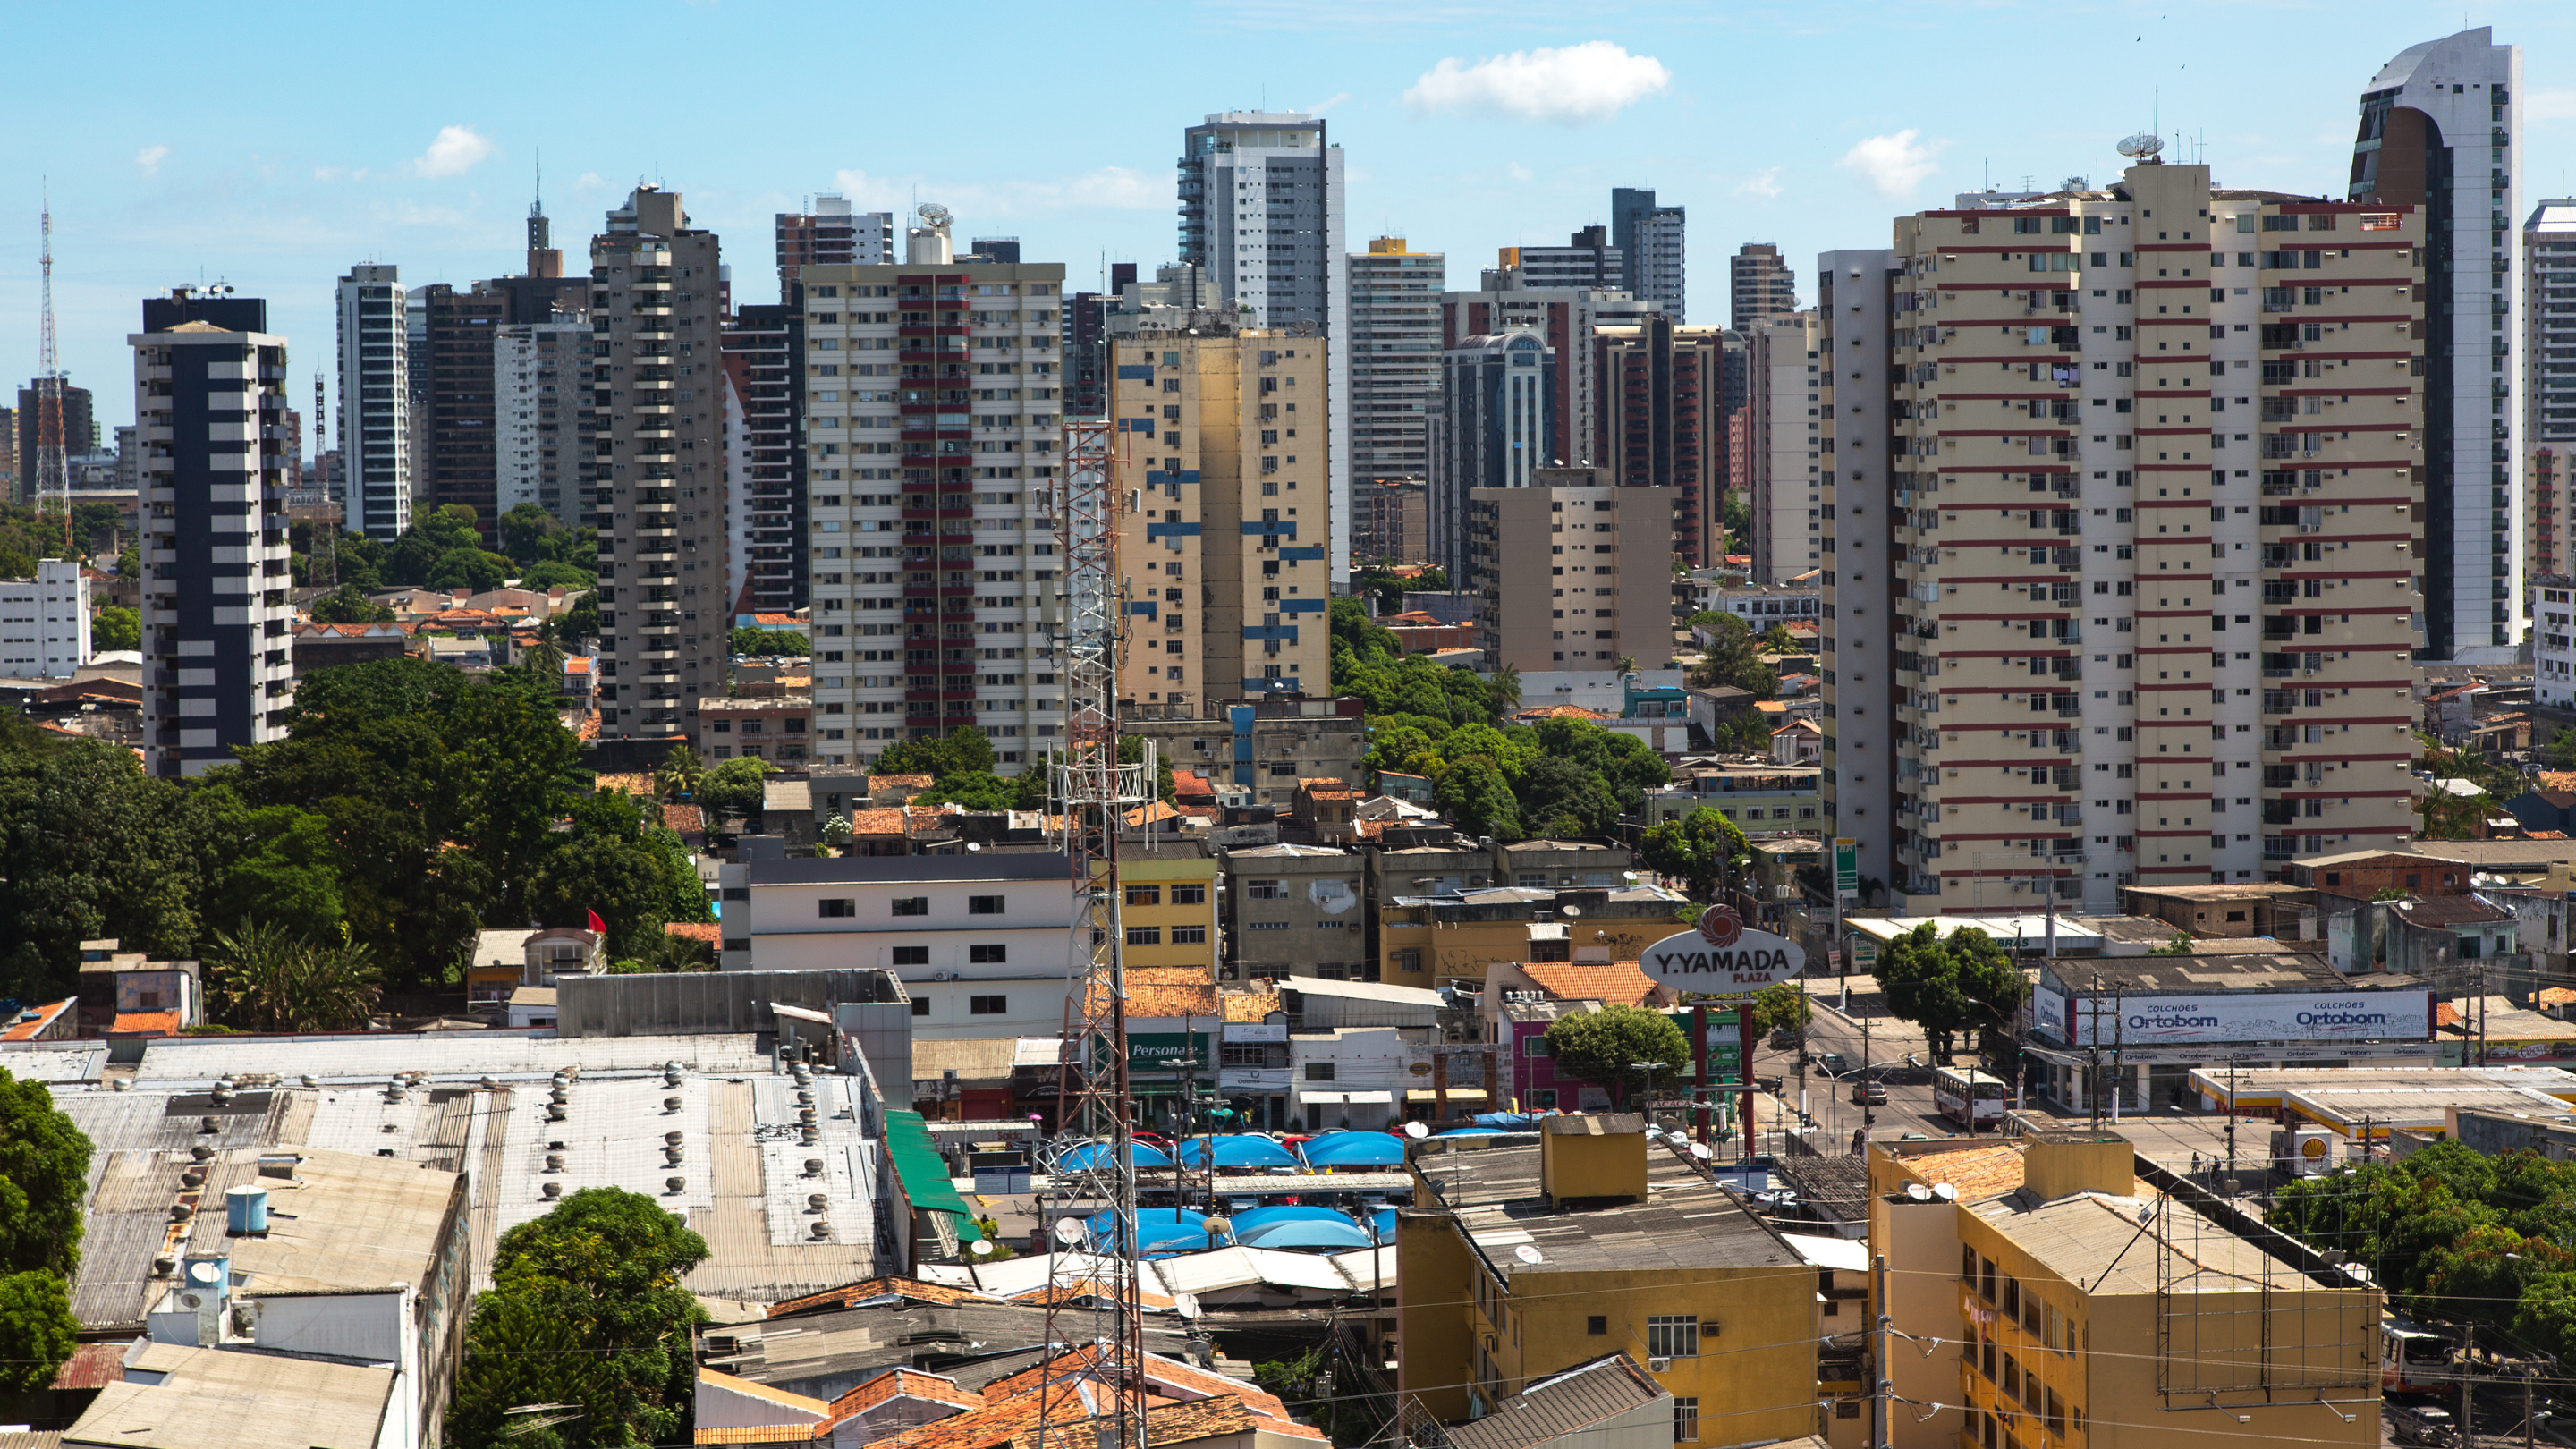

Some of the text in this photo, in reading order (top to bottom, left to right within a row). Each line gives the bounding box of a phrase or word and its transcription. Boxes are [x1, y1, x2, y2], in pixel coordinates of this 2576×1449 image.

[1838, 844, 1853, 853] BR
[1655, 949, 1790, 975] Y.YAMADA
[1733, 972, 1772, 983] PLAZA
[2147, 1004, 2198, 1013] COLCHÕES
[2314, 1001, 2365, 1010] COLCHÕES
[2128, 1014, 2218, 1030] Ortobom
[2296, 1011, 2385, 1025] Ortobom
[1132, 1044, 1199, 1057] Personae
[997, 1131, 1023, 1140] Saída
